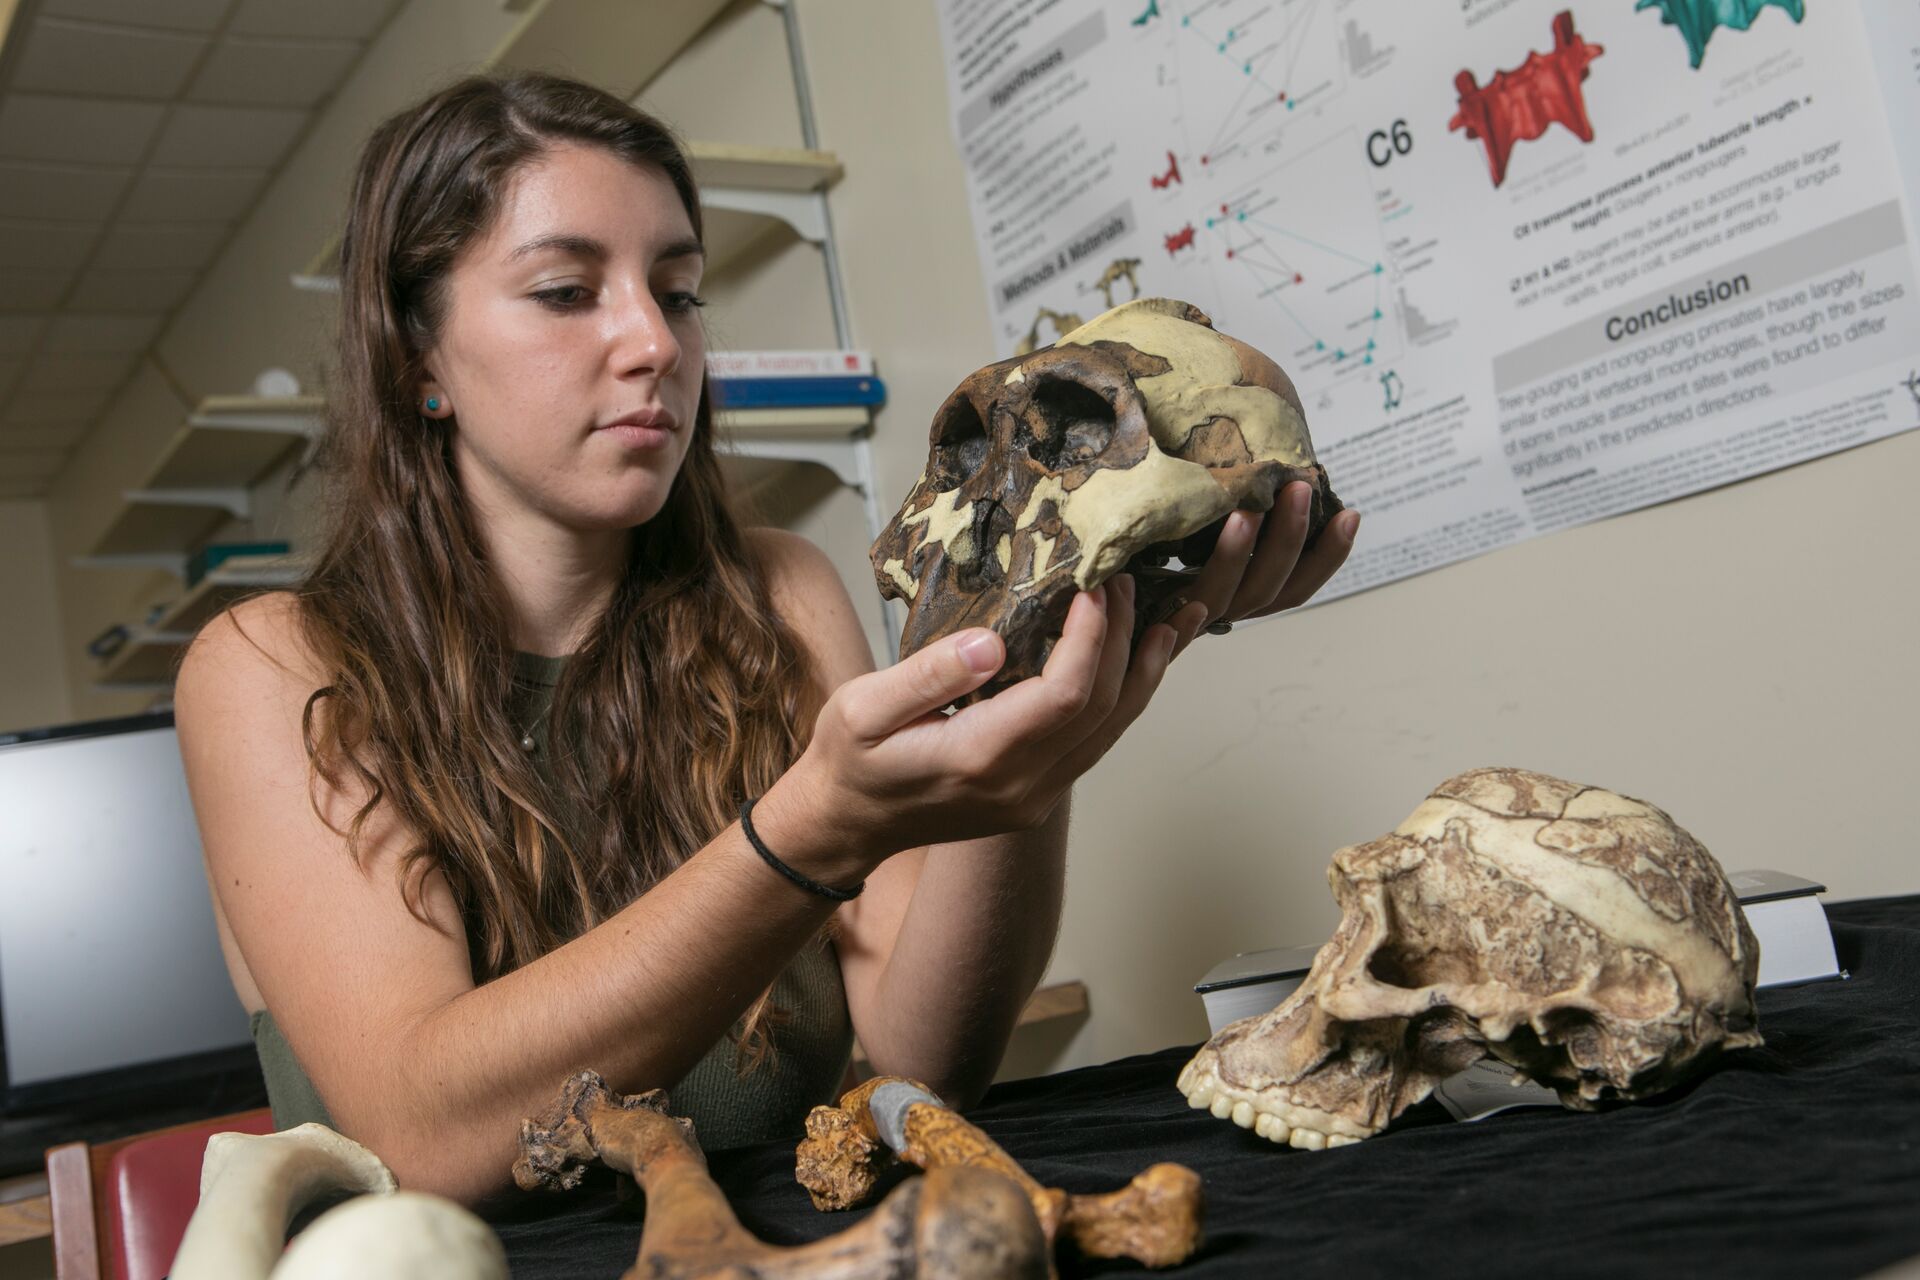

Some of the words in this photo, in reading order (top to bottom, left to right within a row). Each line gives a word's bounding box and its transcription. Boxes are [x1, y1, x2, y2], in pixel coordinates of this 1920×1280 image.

[990, 48, 1063, 111] Hypotheses
[1367, 118, 1412, 167] C6
[1595, 174, 1643, 204] process
[1647, 150, 1694, 179] anterior
[1697, 121, 1752, 154] tubercle
[1754, 99, 1800, 127] length
[1003, 263, 1056, 300] Methods
[1057, 252, 1067, 270] &
[1068, 217, 1125, 262] Materials
[1581, 360, 1608, 383] and
[1609, 331, 1695, 370] nongouging
[1697, 306, 1765, 343] primates
[1767, 290, 1808, 314] have
[1809, 269, 1865, 300] largely
[1606, 274, 1750, 342] Conclusion
[1519, 428, 1555, 450] some
[1557, 412, 1605, 437] muscle
[1608, 382, 1690, 422] attachment
[1692, 370, 1729, 392] sites
[1731, 355, 1770, 380] were
[1771, 336, 1820, 366] found
[1822, 331, 1842, 351] to
[1844, 315, 1888, 343] differ
[1541, 390, 1590, 420] cervical
[1592, 367, 1653, 398] vertebral
[1766, 309, 1824, 342] though
[1827, 299, 1857, 321] the
[1860, 283, 1905, 311] sizes
[1512, 443, 1582, 479] significantly
[1584, 438, 1598, 452] in
[1598, 429, 1623, 450] the
[1624, 405, 1694, 443] predicted
